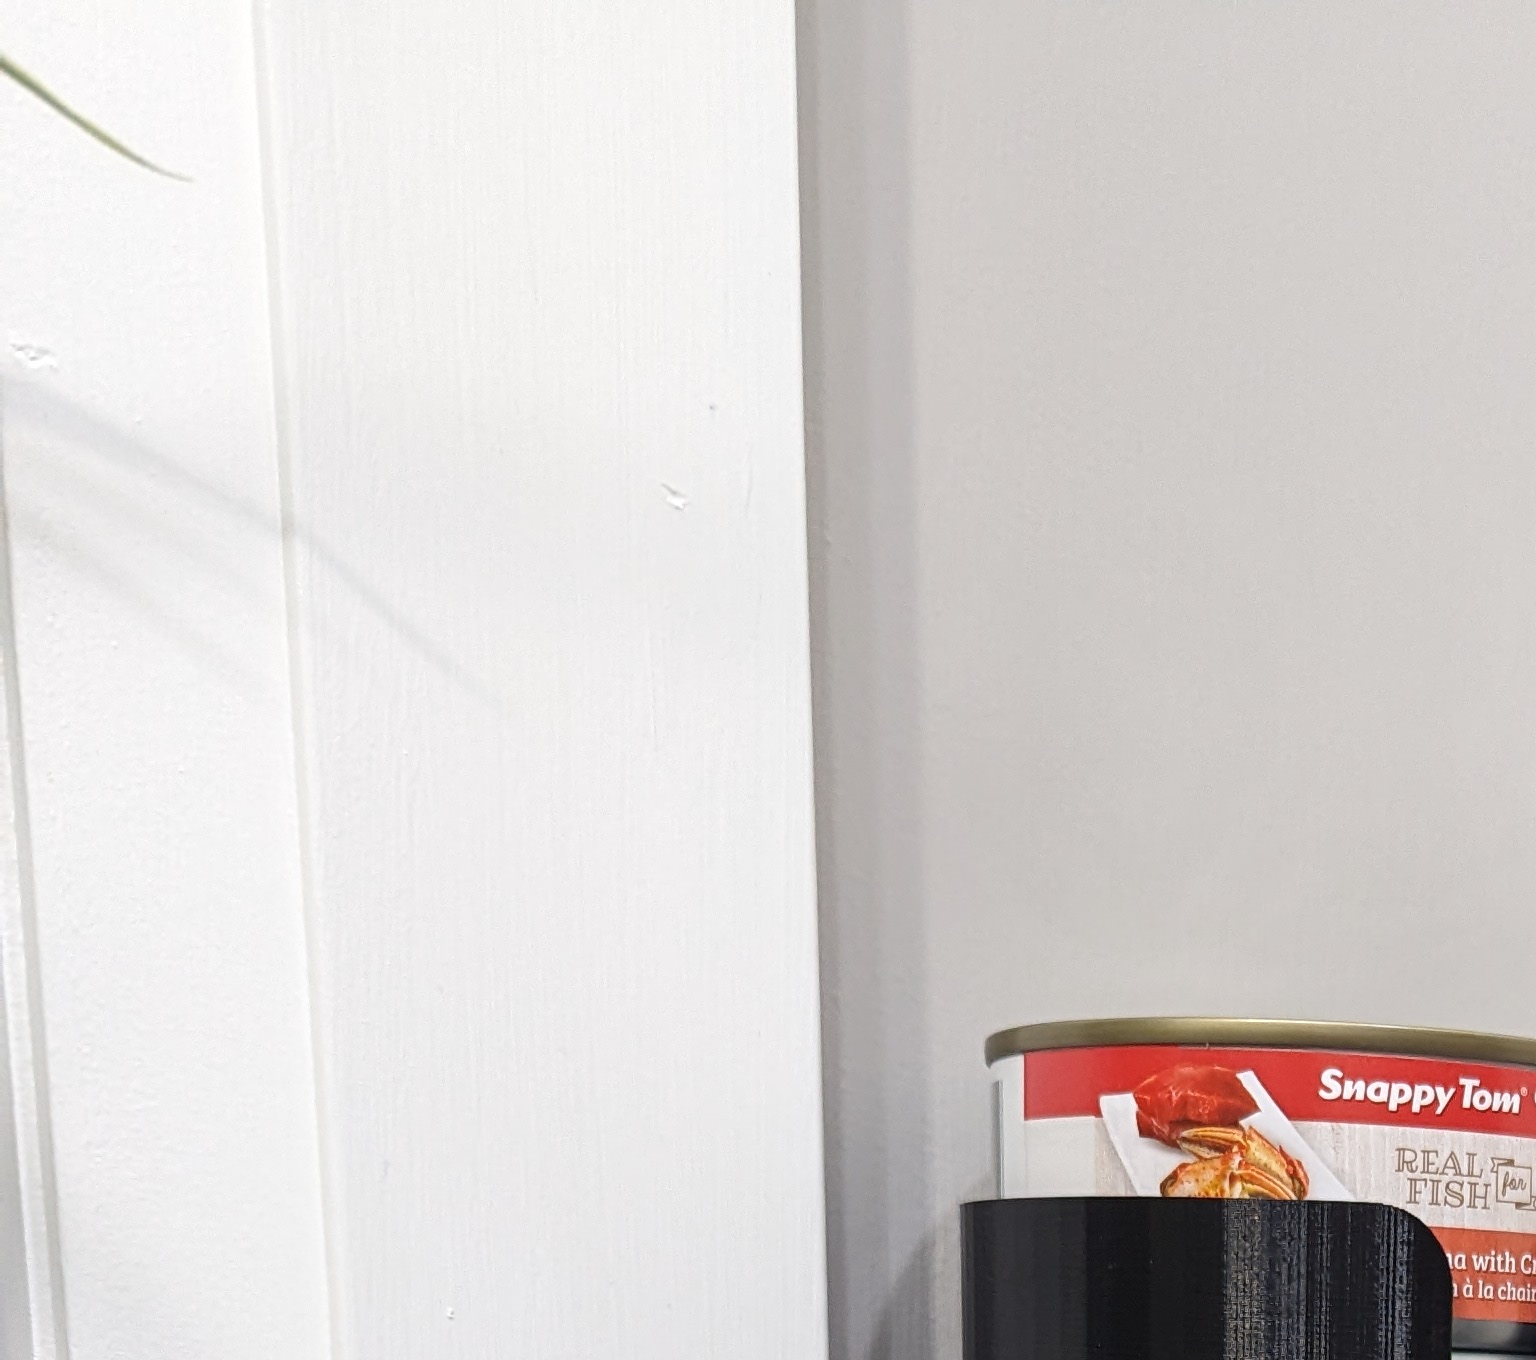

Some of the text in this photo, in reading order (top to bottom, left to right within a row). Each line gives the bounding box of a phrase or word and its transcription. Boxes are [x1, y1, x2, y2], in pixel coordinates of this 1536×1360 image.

[1319, 1069, 1455, 1114] Snappy
[1395, 1148, 1484, 1179] REAL
[1502, 1171, 1527, 1193] for
[1407, 1178, 1492, 1210] FISH
[1472, 1250, 1516, 1274] with
[1462, 1277, 1474, 1299] à
[1478, 1280, 1494, 1299] la
